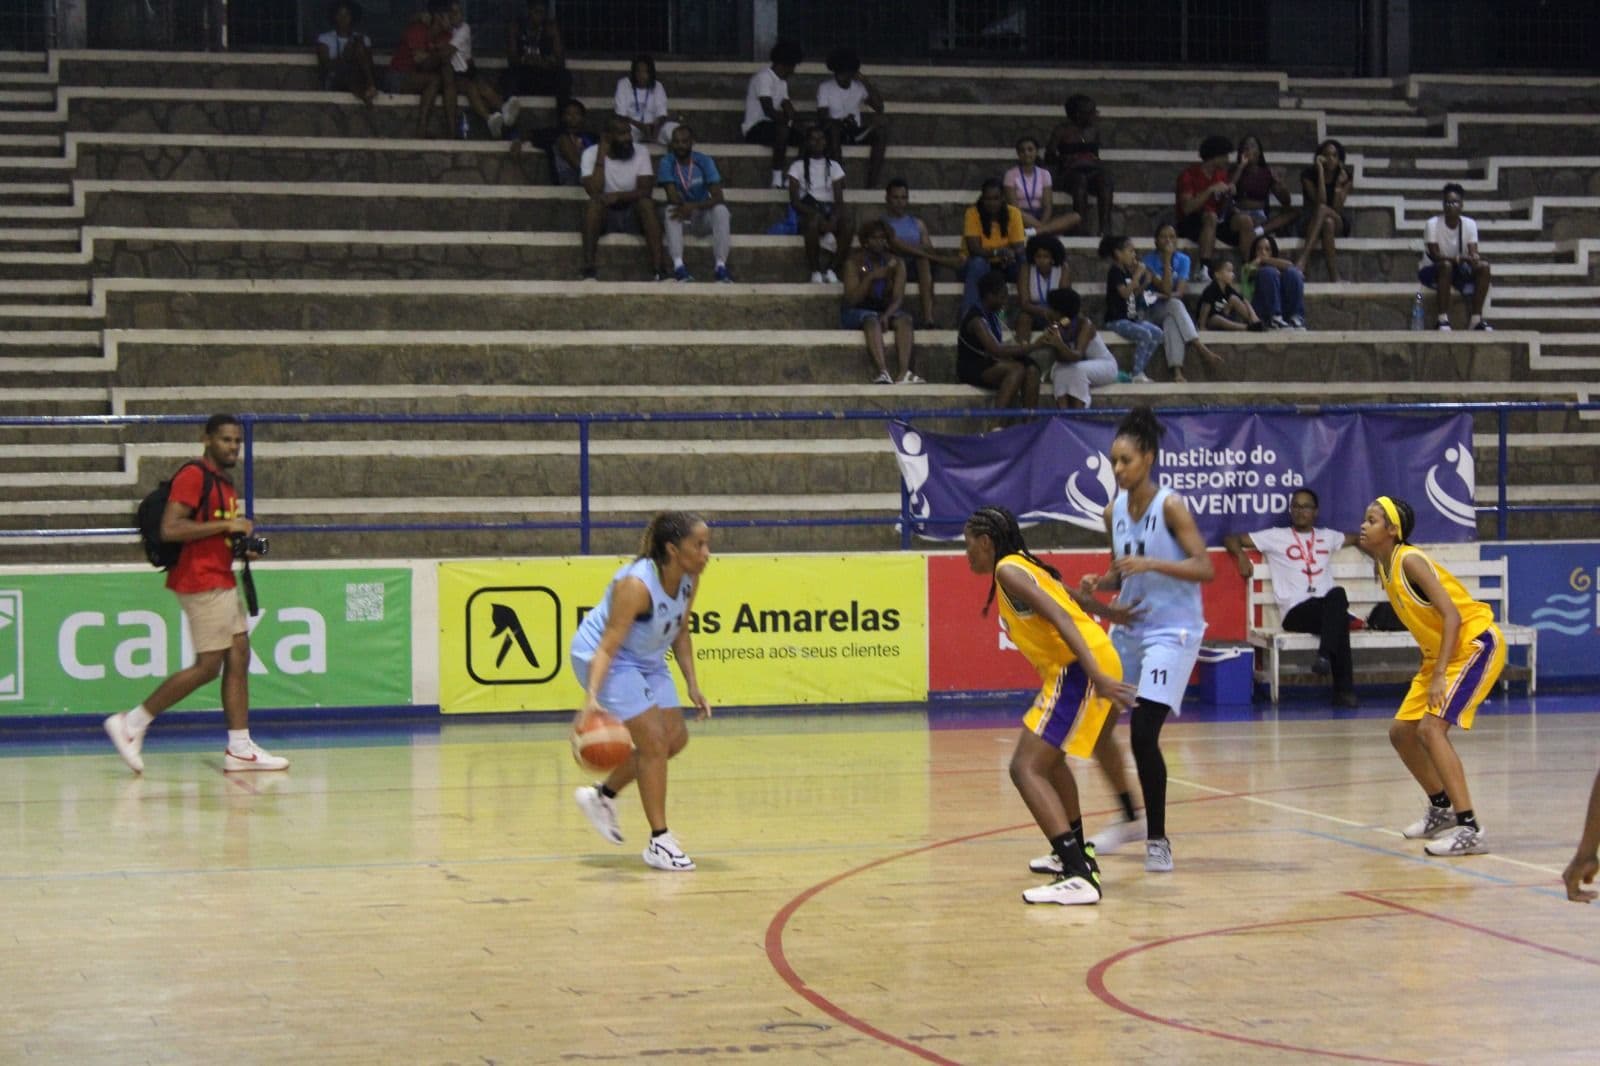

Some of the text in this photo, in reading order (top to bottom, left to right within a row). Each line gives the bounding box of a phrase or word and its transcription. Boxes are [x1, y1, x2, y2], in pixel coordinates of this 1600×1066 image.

[1159, 445, 1276, 467] Instituto do
[1159, 469, 1304, 489] DESPORTO e da
[1183, 493, 1293, 515] VENTUD
[1144, 514, 1157, 531] 11
[733, 601, 900, 632] Amarelas
[697, 642, 900, 662] empresa aos seus clientes
[1150, 667, 1168, 686] 11
